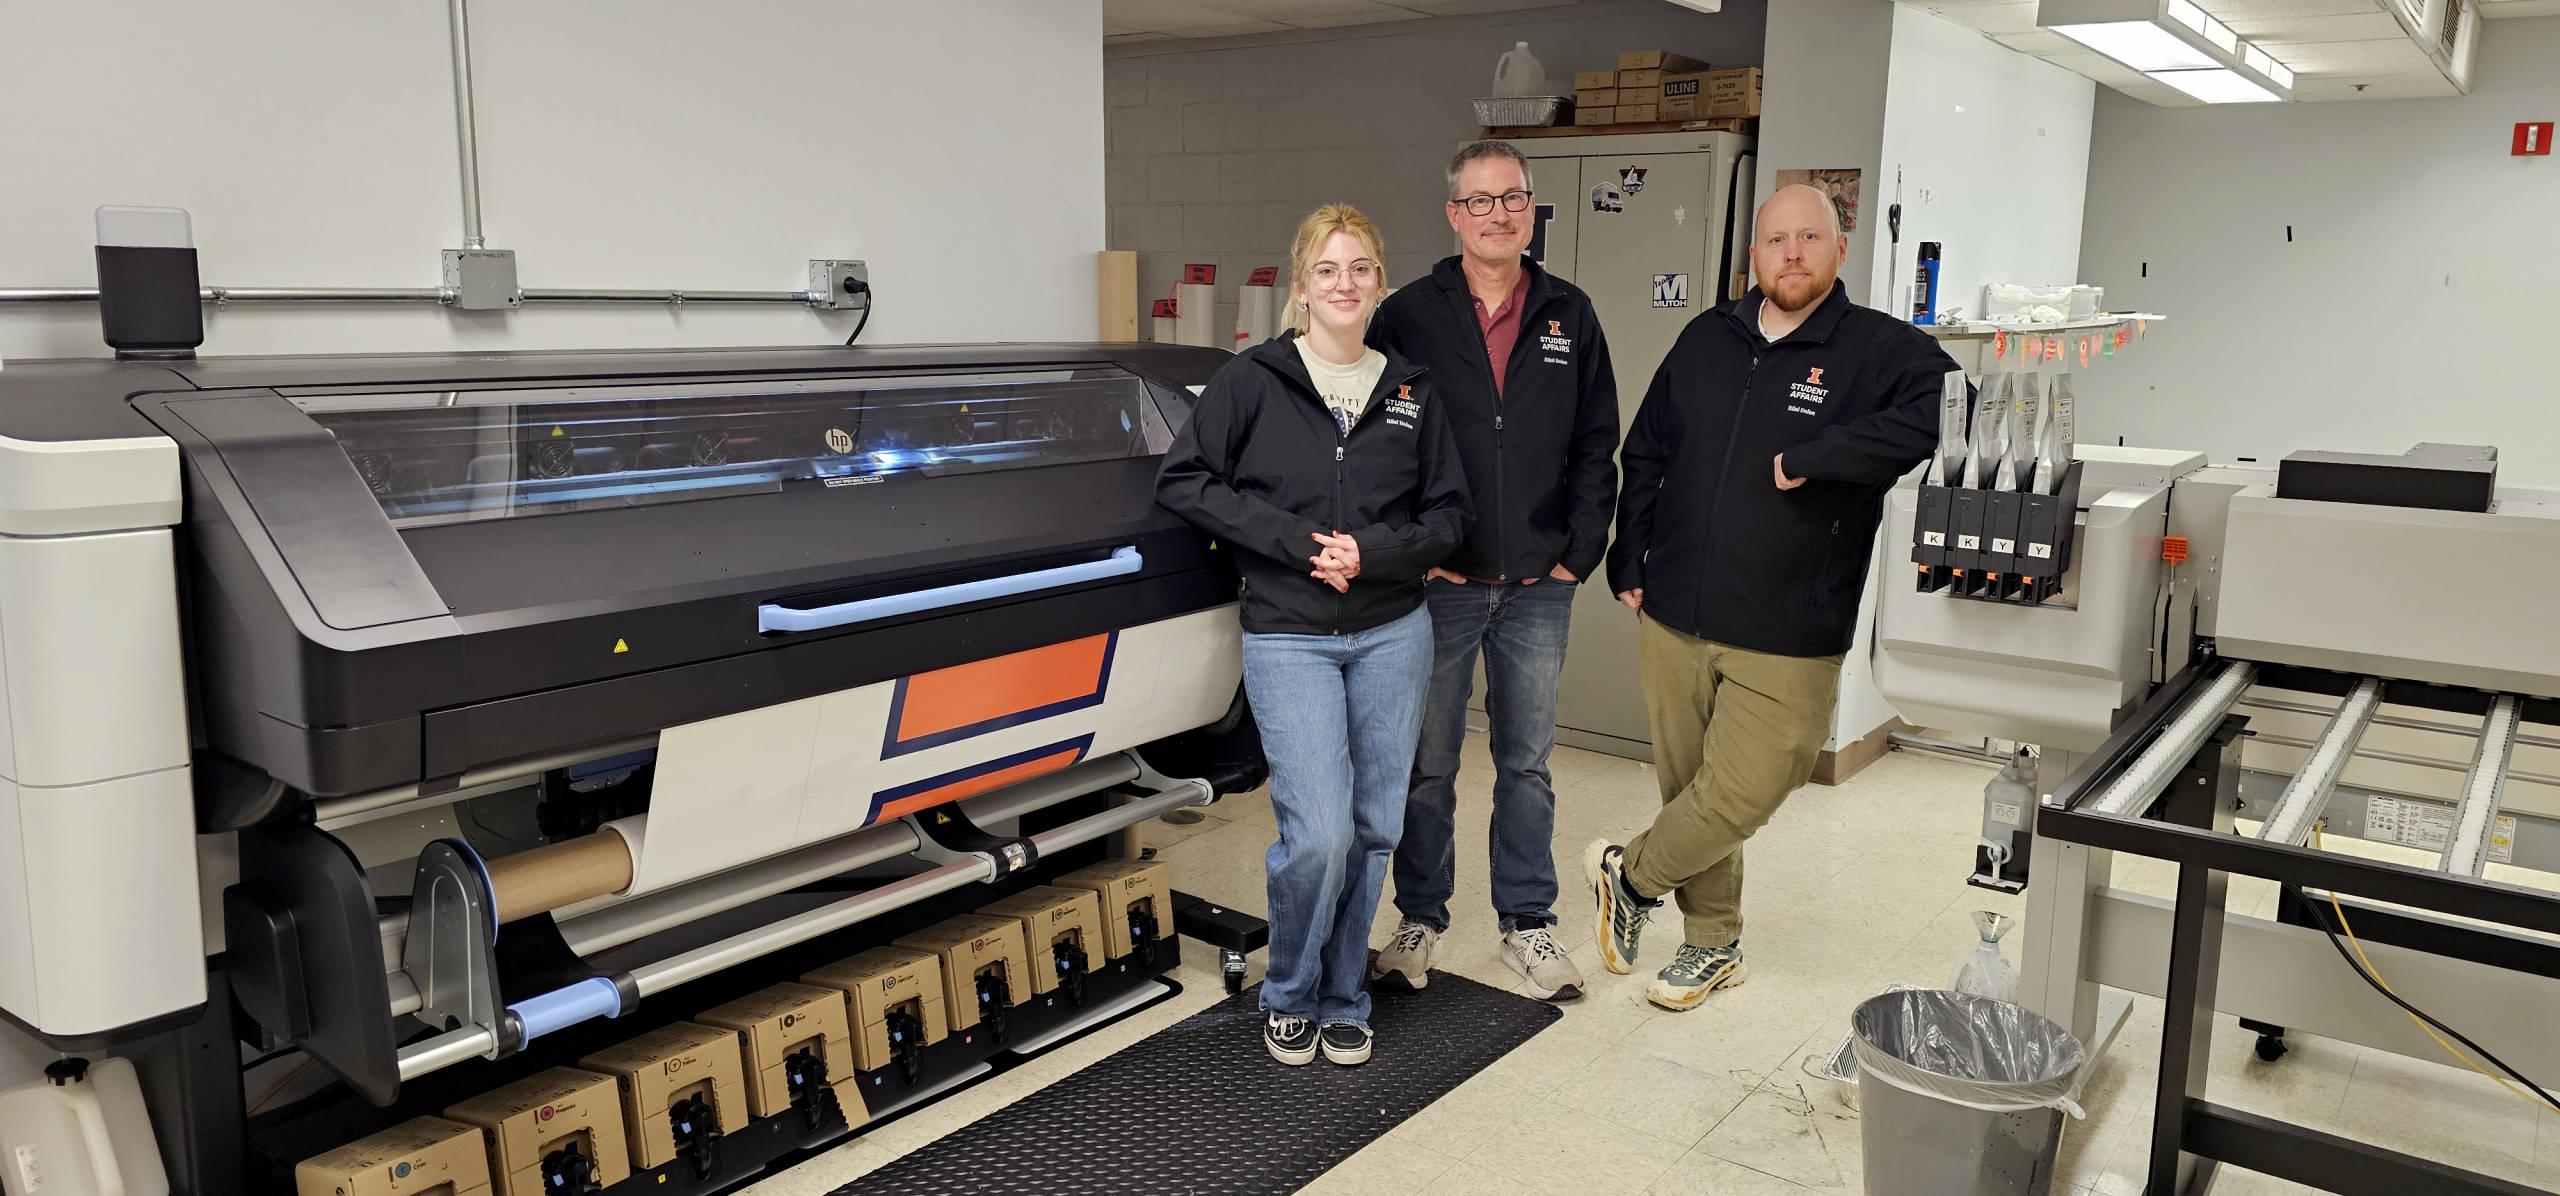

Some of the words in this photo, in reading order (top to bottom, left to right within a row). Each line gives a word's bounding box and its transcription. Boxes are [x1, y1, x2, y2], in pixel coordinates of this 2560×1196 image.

[1666, 81, 1697, 95] ULINE
[1540, 336, 1571, 346] STUDENT
[1542, 343, 1570, 353] AFFAIRS
[1790, 383, 1829, 397] STUDENT
[1790, 391, 1824, 404] AFFAIRS
[1385, 399, 1420, 412] STUDENT
[1385, 405, 1418, 419] AFFAIRS
[829, 429, 849, 453] hp
[1930, 535, 1939, 544] K
[1965, 538, 1973, 547] K
[2000, 542, 2007, 550] Y
[2036, 546, 2044, 555] Y
[682, 1058, 697, 1066] Yellow
[555, 1104, 576, 1114] Magenta
[413, 1161, 427, 1170] Cyan
